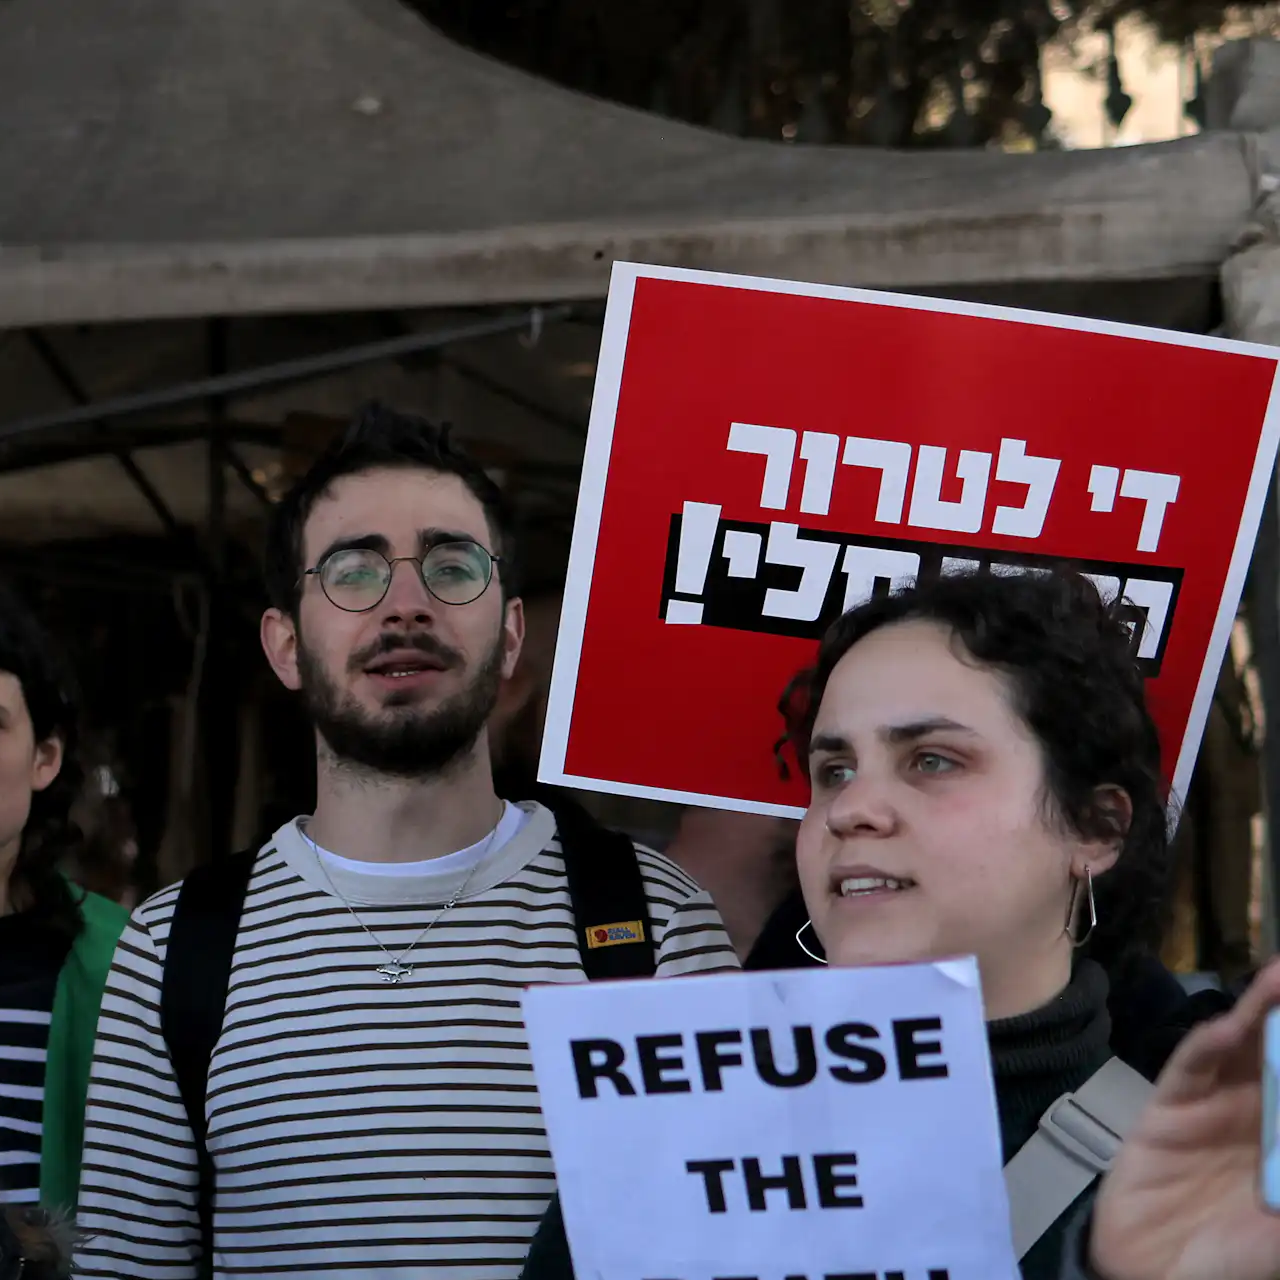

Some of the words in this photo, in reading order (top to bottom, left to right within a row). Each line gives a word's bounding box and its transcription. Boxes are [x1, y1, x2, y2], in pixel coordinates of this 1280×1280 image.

[726, 422, 1062, 538] לטרור
[1087, 464, 1181, 553] די
[570, 1017, 949, 1099] REFUSE
[686, 1152, 864, 1214] THE
